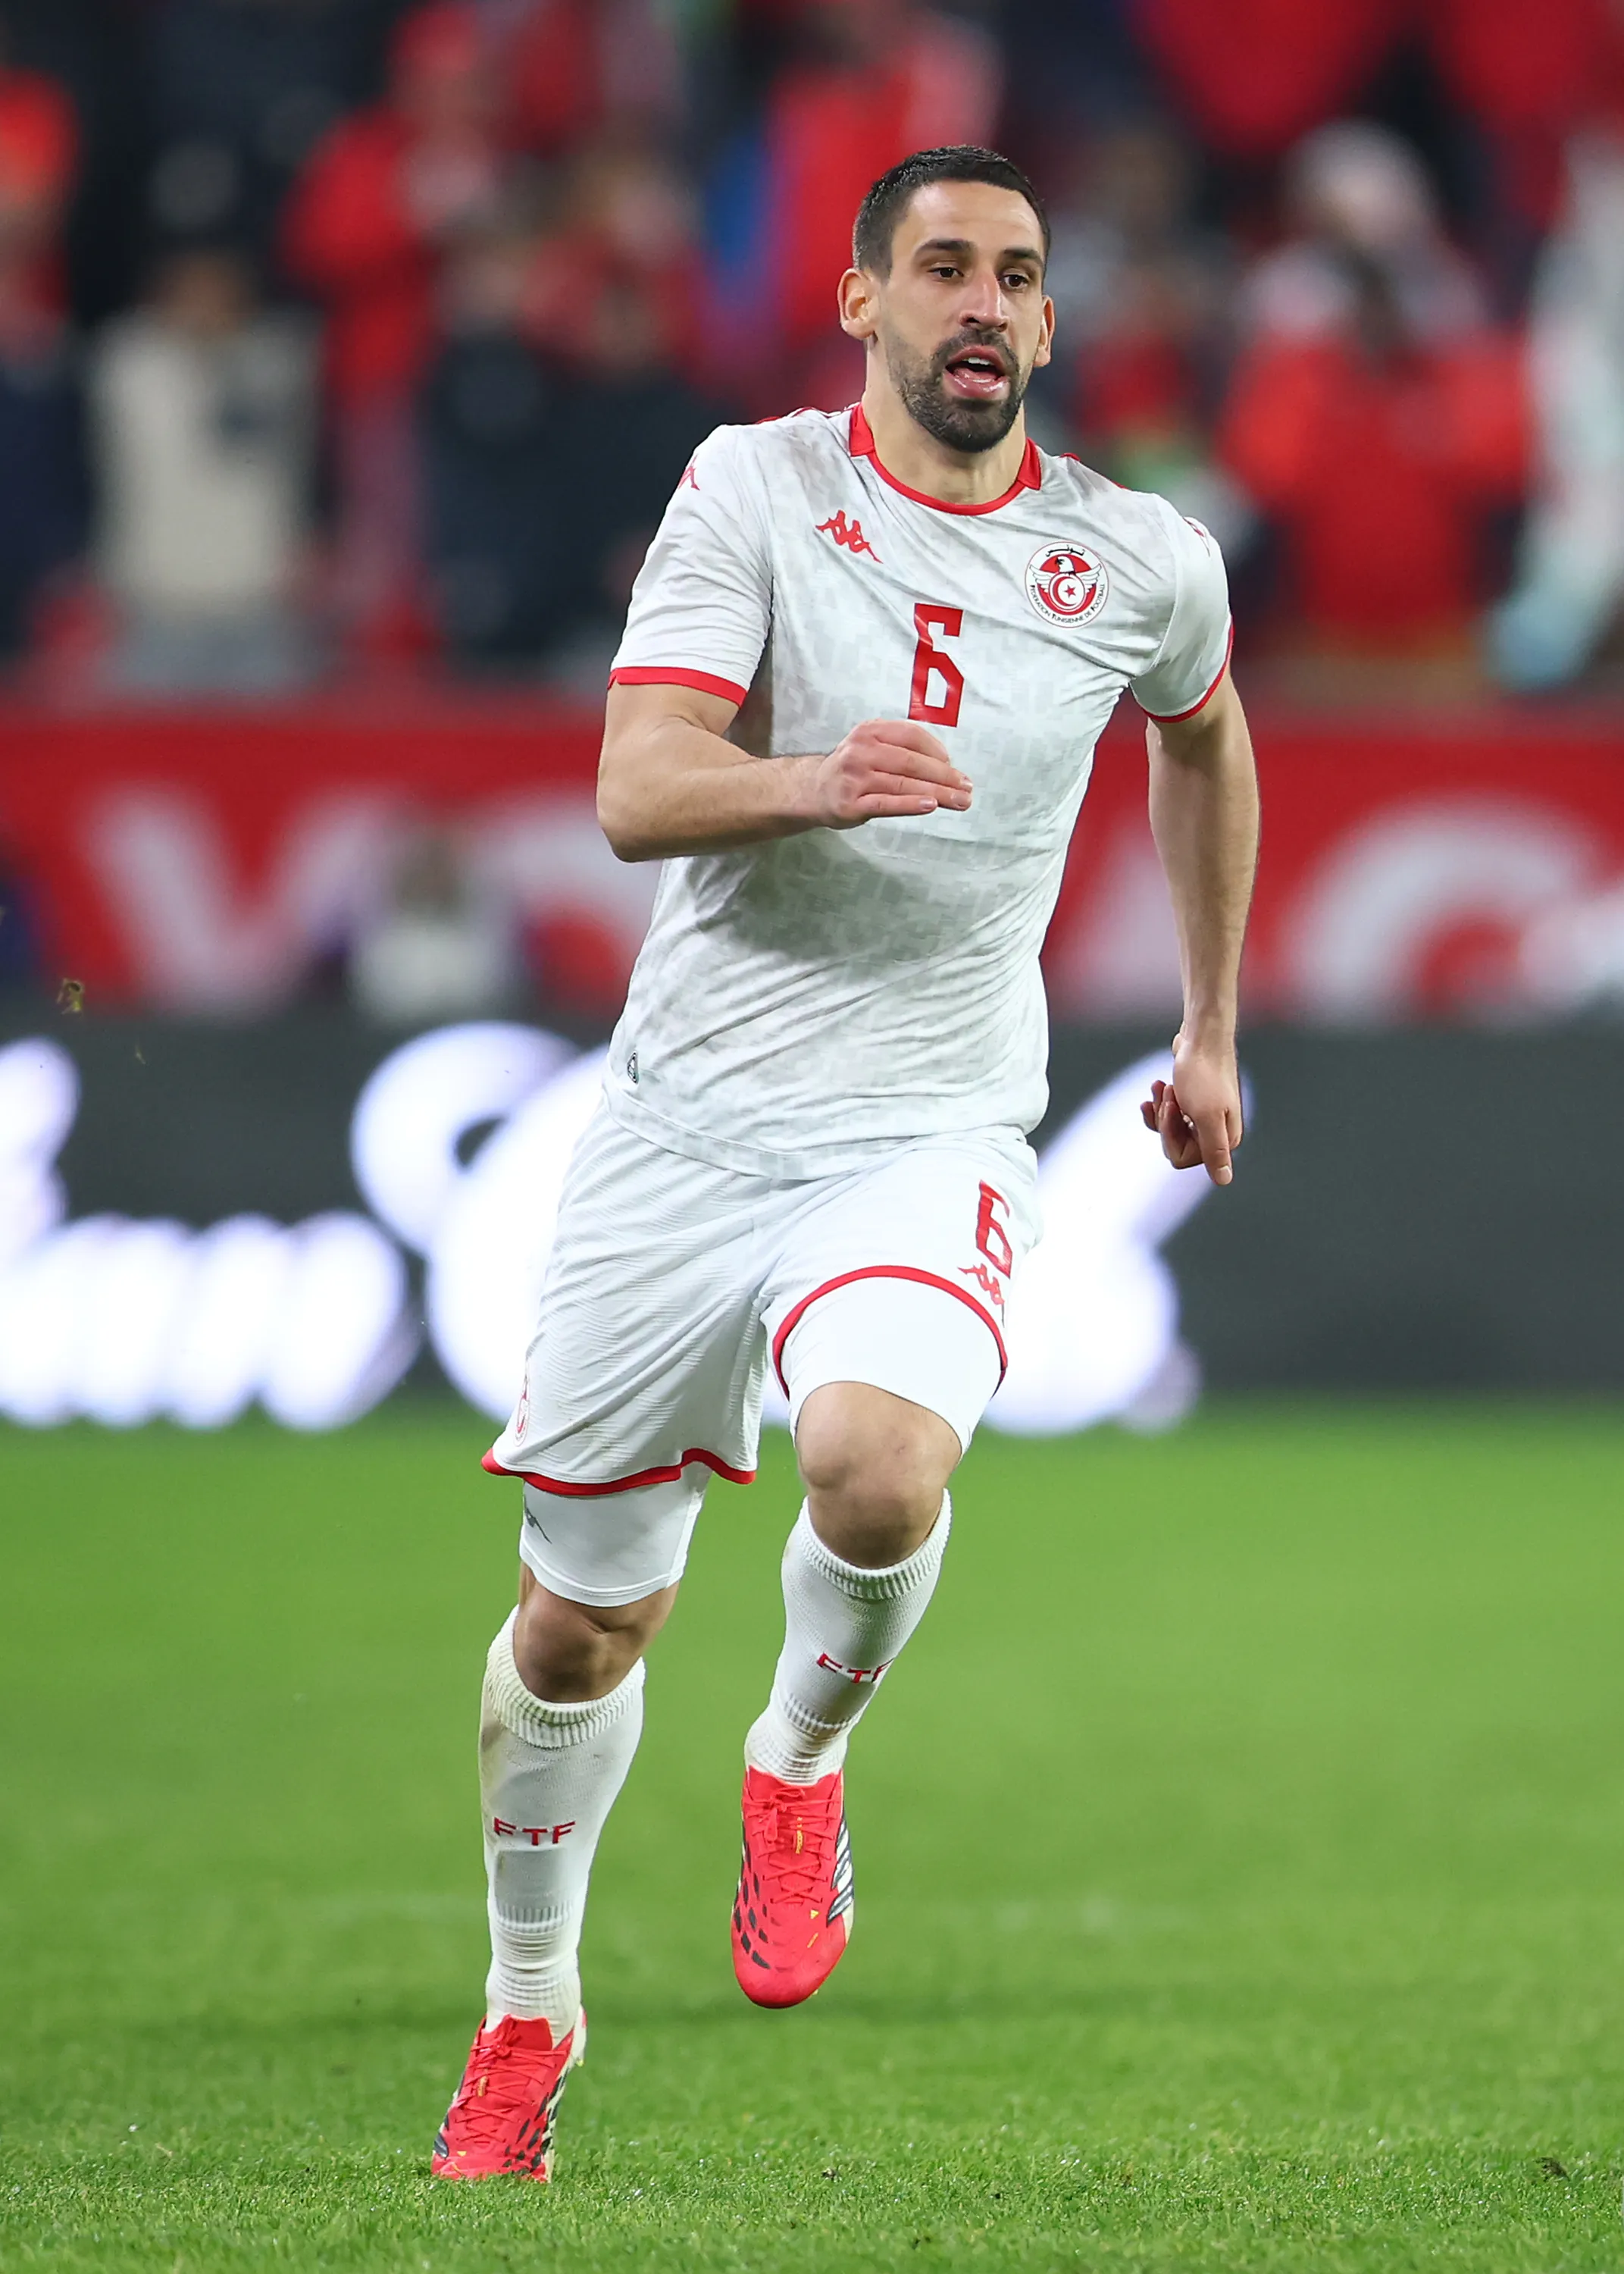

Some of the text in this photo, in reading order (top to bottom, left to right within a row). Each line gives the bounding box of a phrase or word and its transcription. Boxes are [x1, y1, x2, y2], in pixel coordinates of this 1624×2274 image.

[1090, 584, 1105, 612] FOOTBALL
[908, 603, 964, 728] 6
[975, 1179, 1012, 1280] 6
[493, 1817, 576, 1846] FTF
